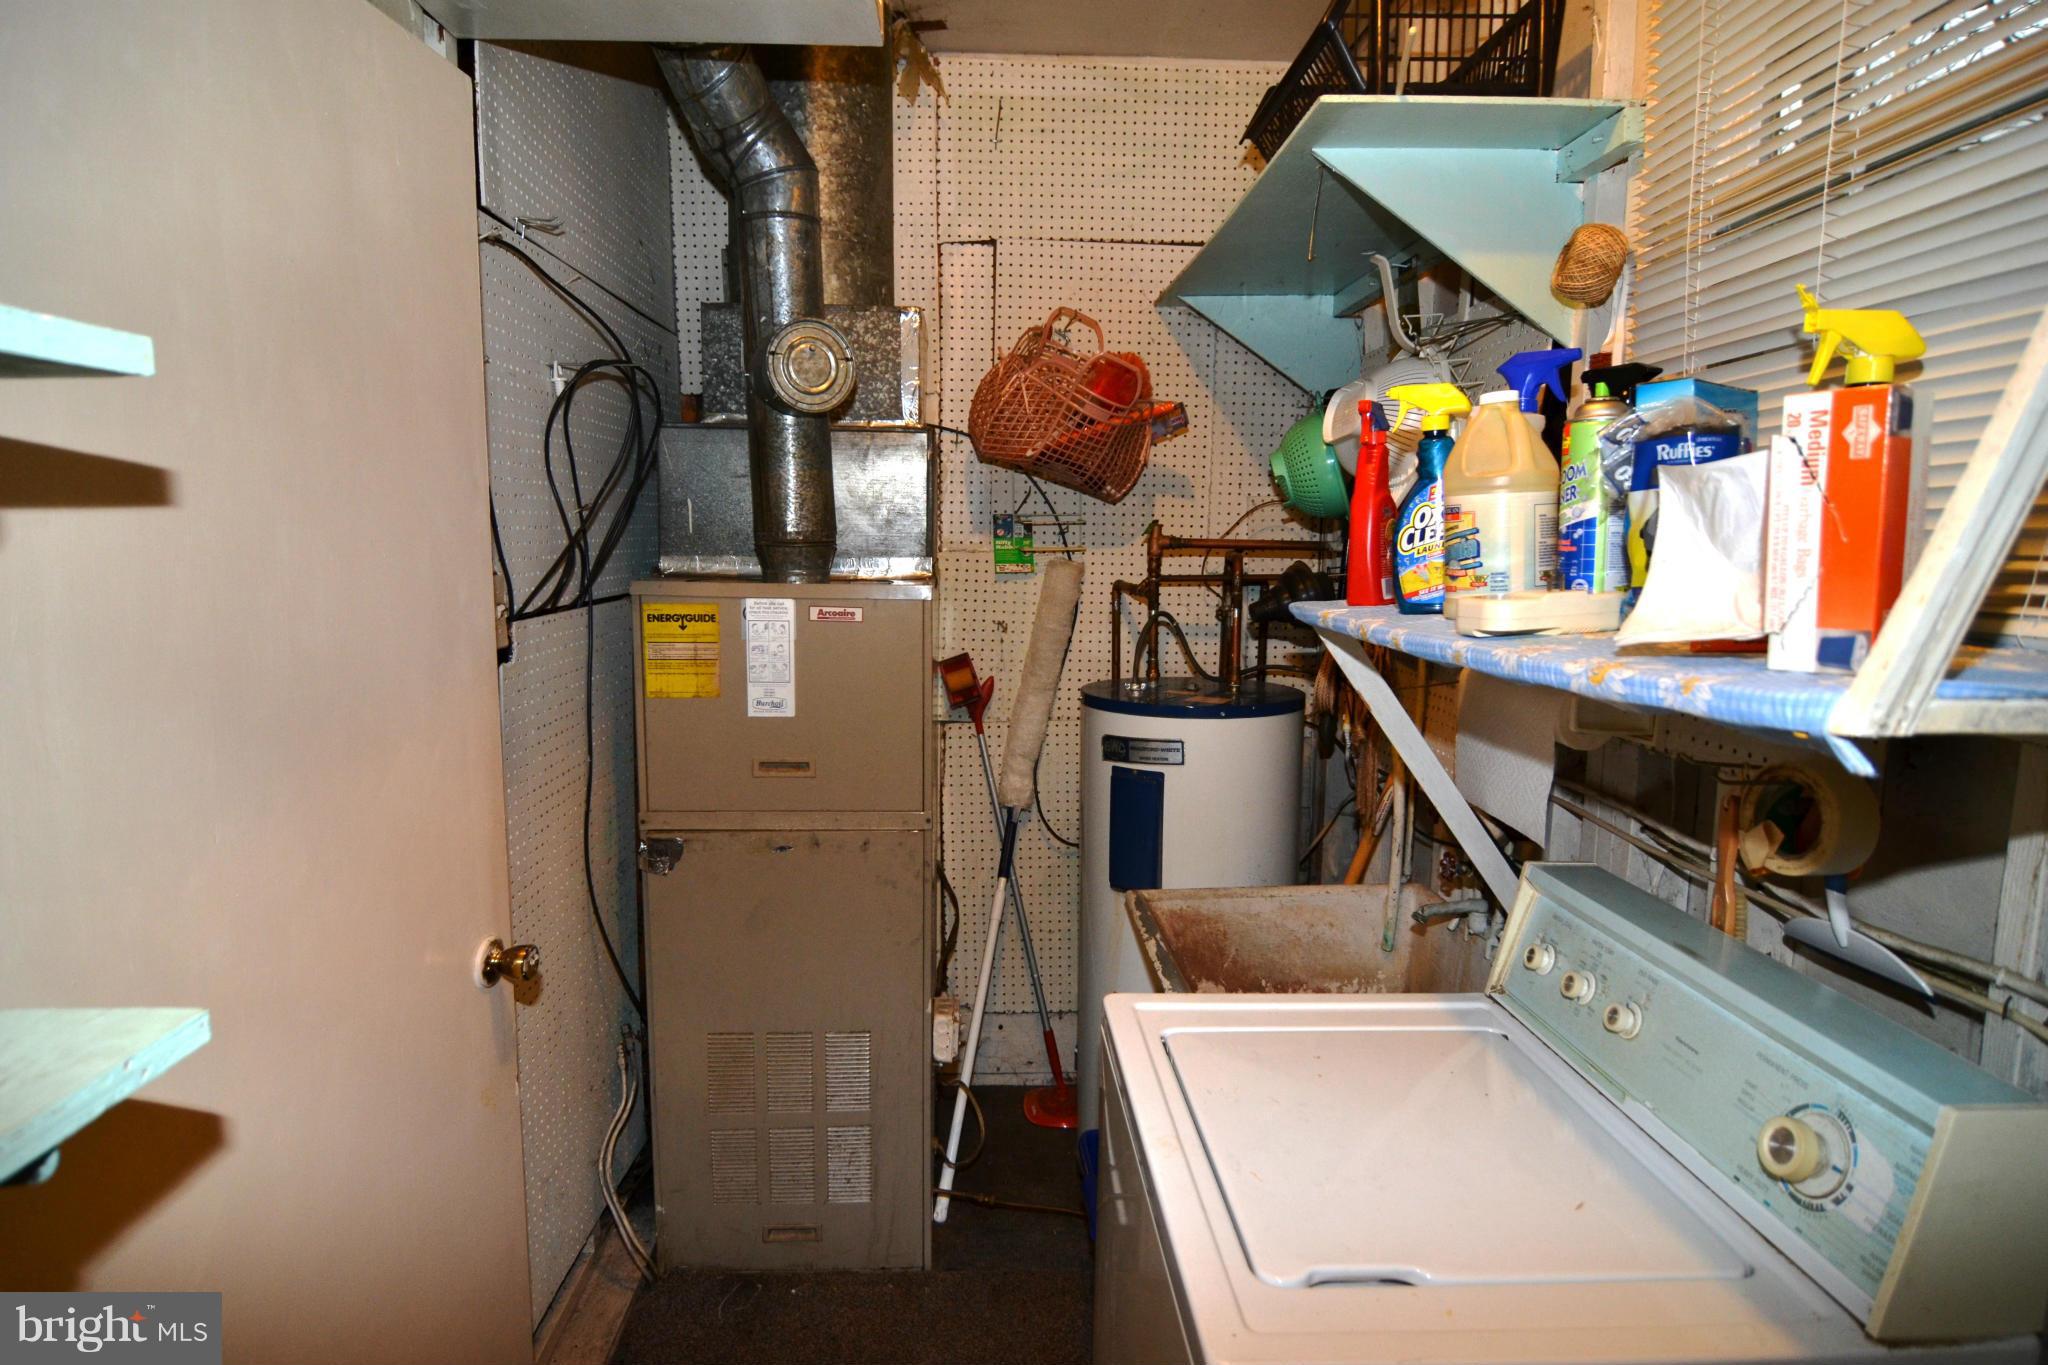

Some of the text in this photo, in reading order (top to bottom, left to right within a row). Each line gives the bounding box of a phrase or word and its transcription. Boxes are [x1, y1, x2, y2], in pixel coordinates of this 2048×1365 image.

[1656, 441, 1713, 461] Ruffies
[1800, 409, 1830, 486] Medium
[646, 613, 717, 624] ENERGYGUIDE
[817, 608, 856, 617] Arcoaire
